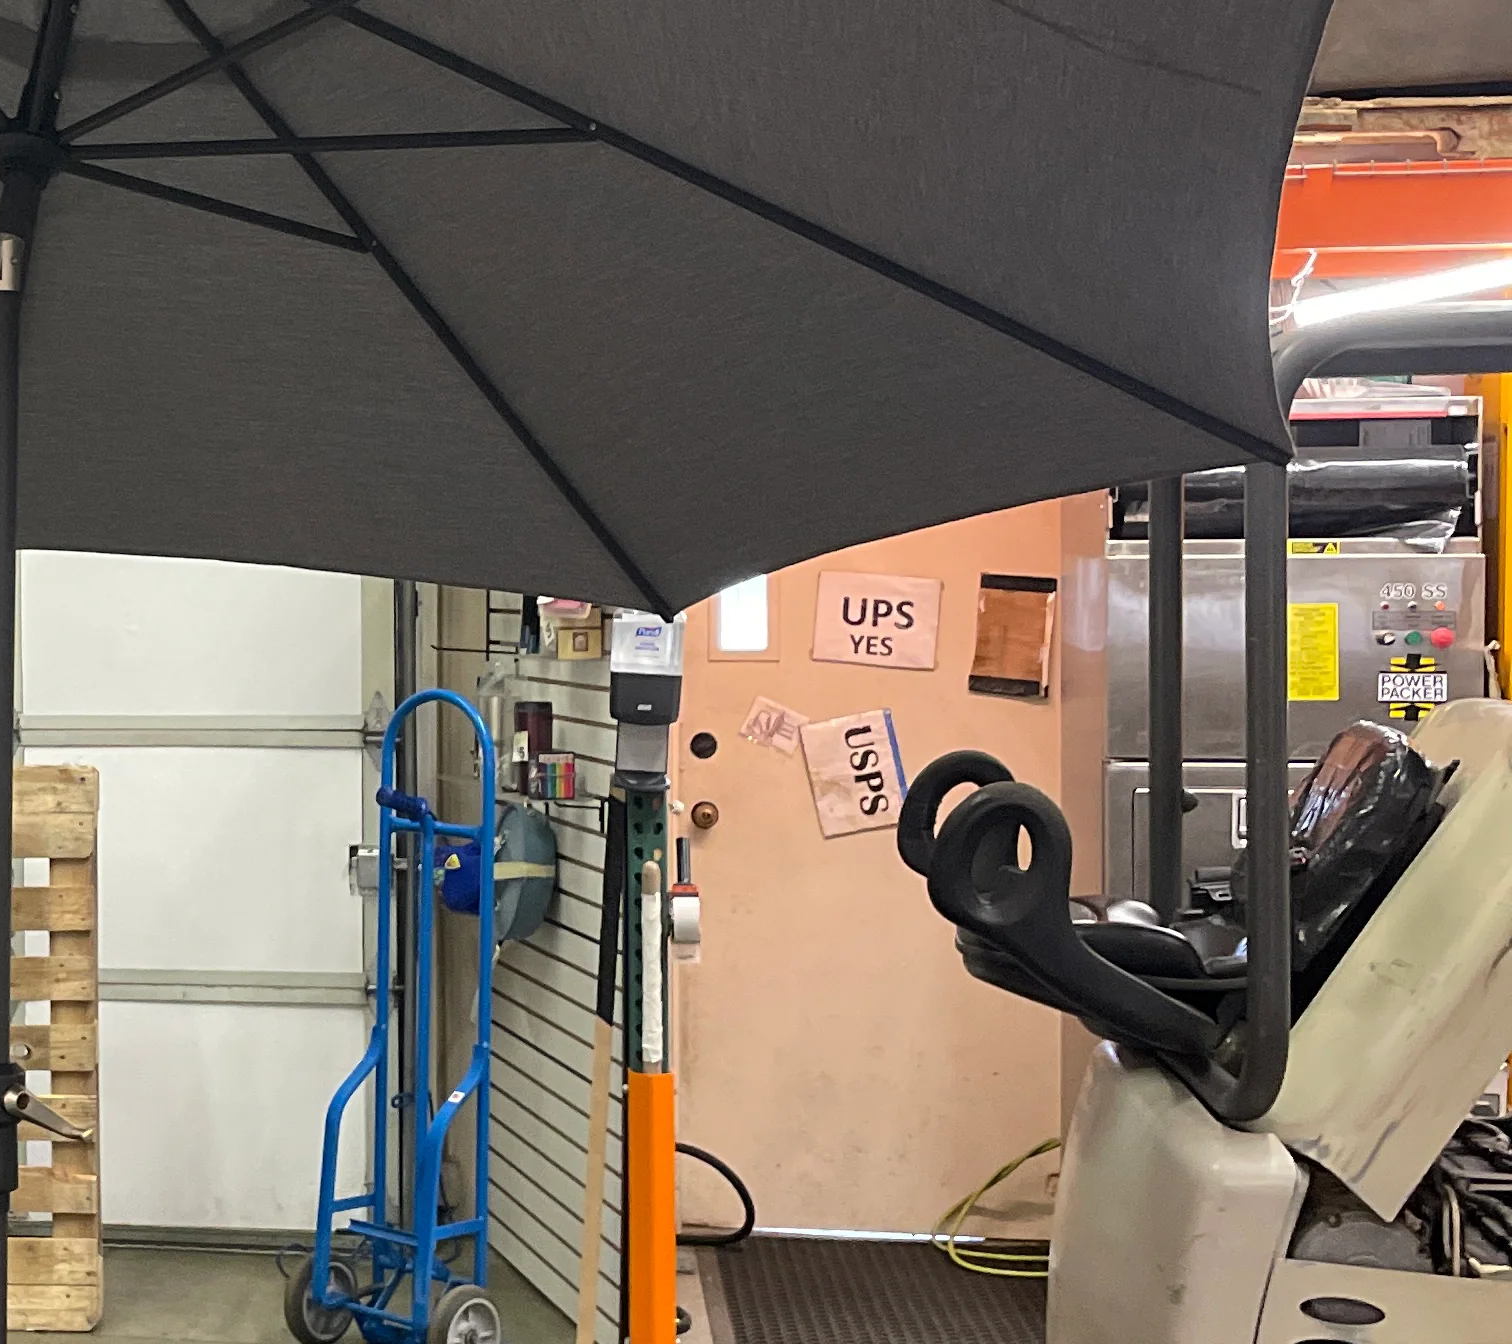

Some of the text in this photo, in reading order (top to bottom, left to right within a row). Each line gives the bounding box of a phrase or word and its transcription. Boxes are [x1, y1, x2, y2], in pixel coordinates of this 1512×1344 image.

[1380, 583, 1448, 599] 450 SS
[842, 596, 915, 630] UPS
[850, 634, 894, 656] YES
[1381, 674, 1444, 687] POWER
[1381, 687, 1444, 700] PACKER
[844, 725, 889, 816] USPS
